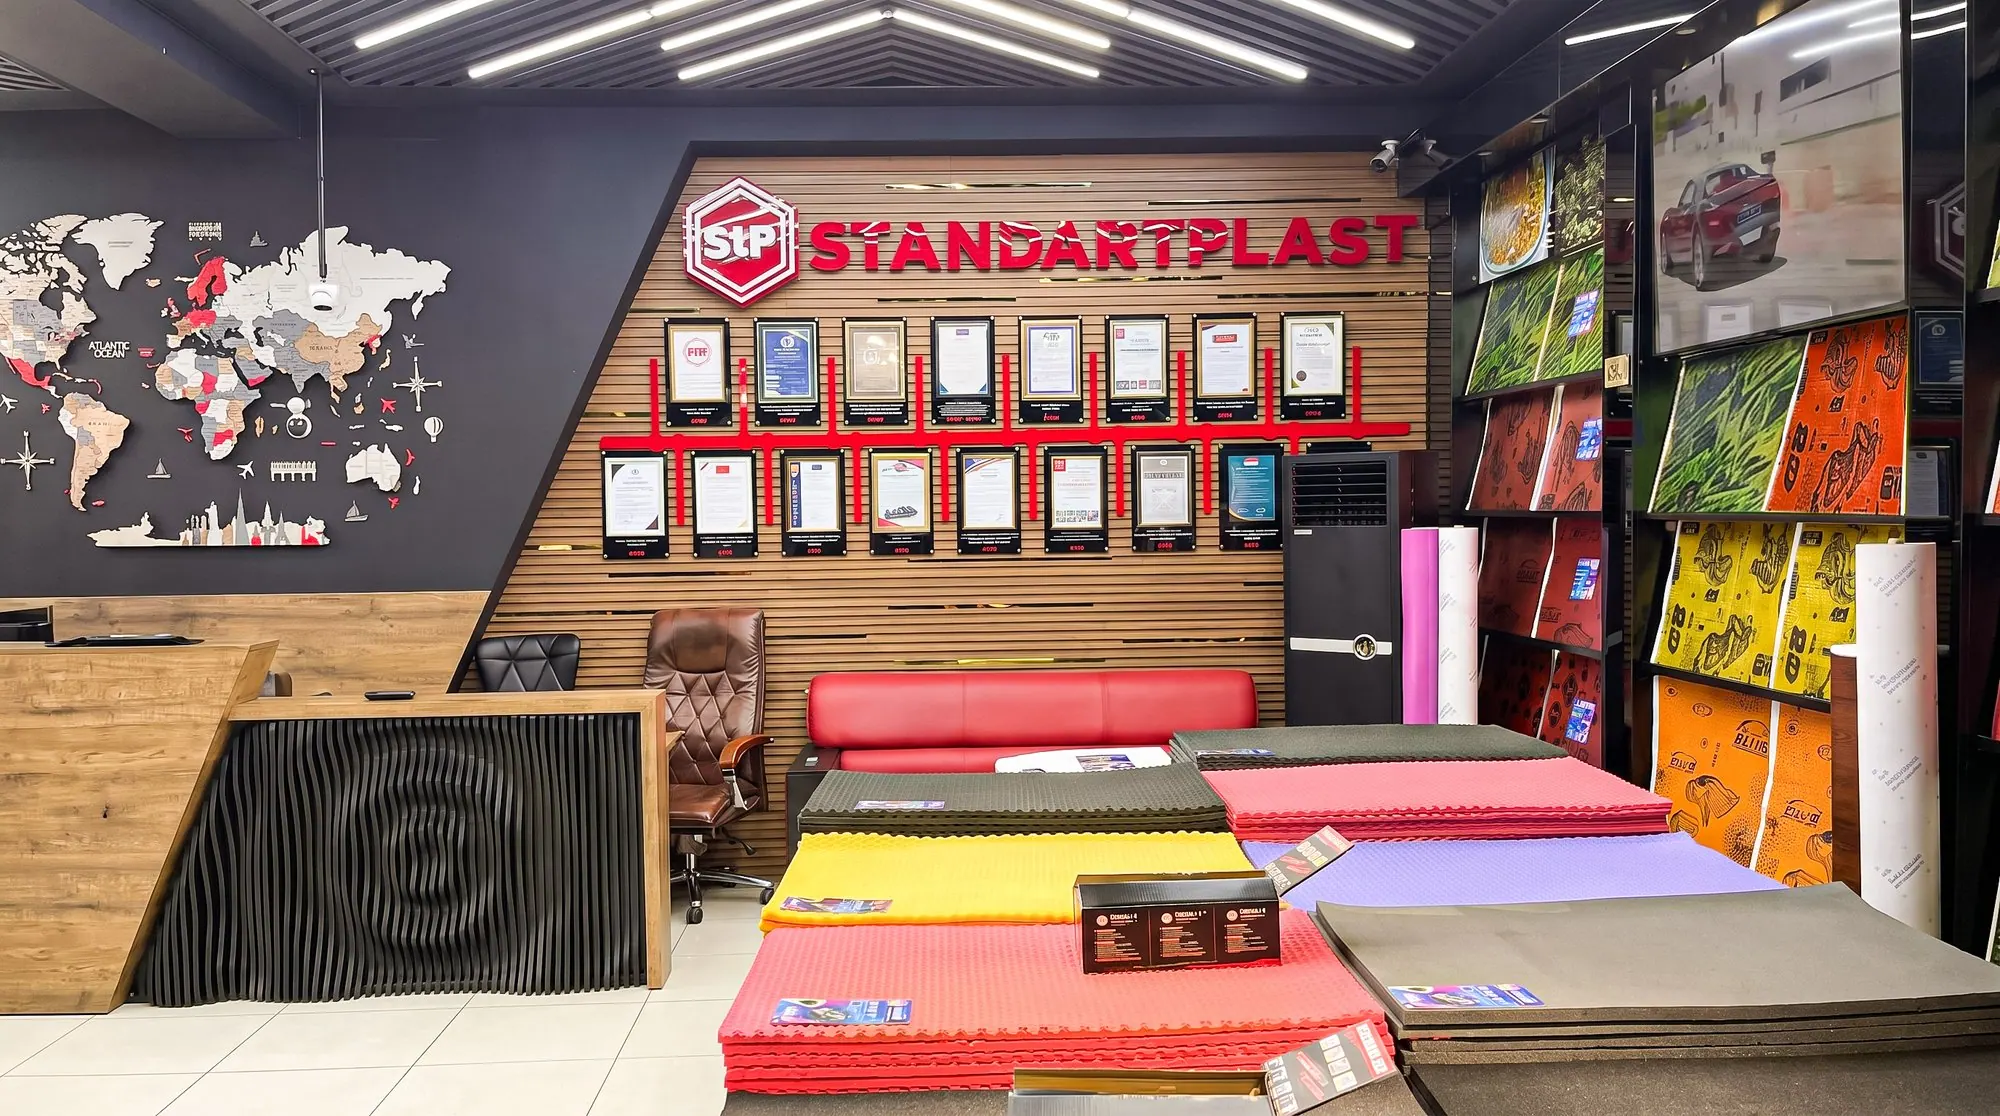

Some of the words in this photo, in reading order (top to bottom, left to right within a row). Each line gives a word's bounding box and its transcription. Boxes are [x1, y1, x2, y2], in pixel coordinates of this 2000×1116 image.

[703, 224, 777, 260] StP
[808, 214, 1419, 272] STANDARTPLAST
[88, 341, 130, 350] ATLANTIC
[94, 350, 125, 358] OCEAN
